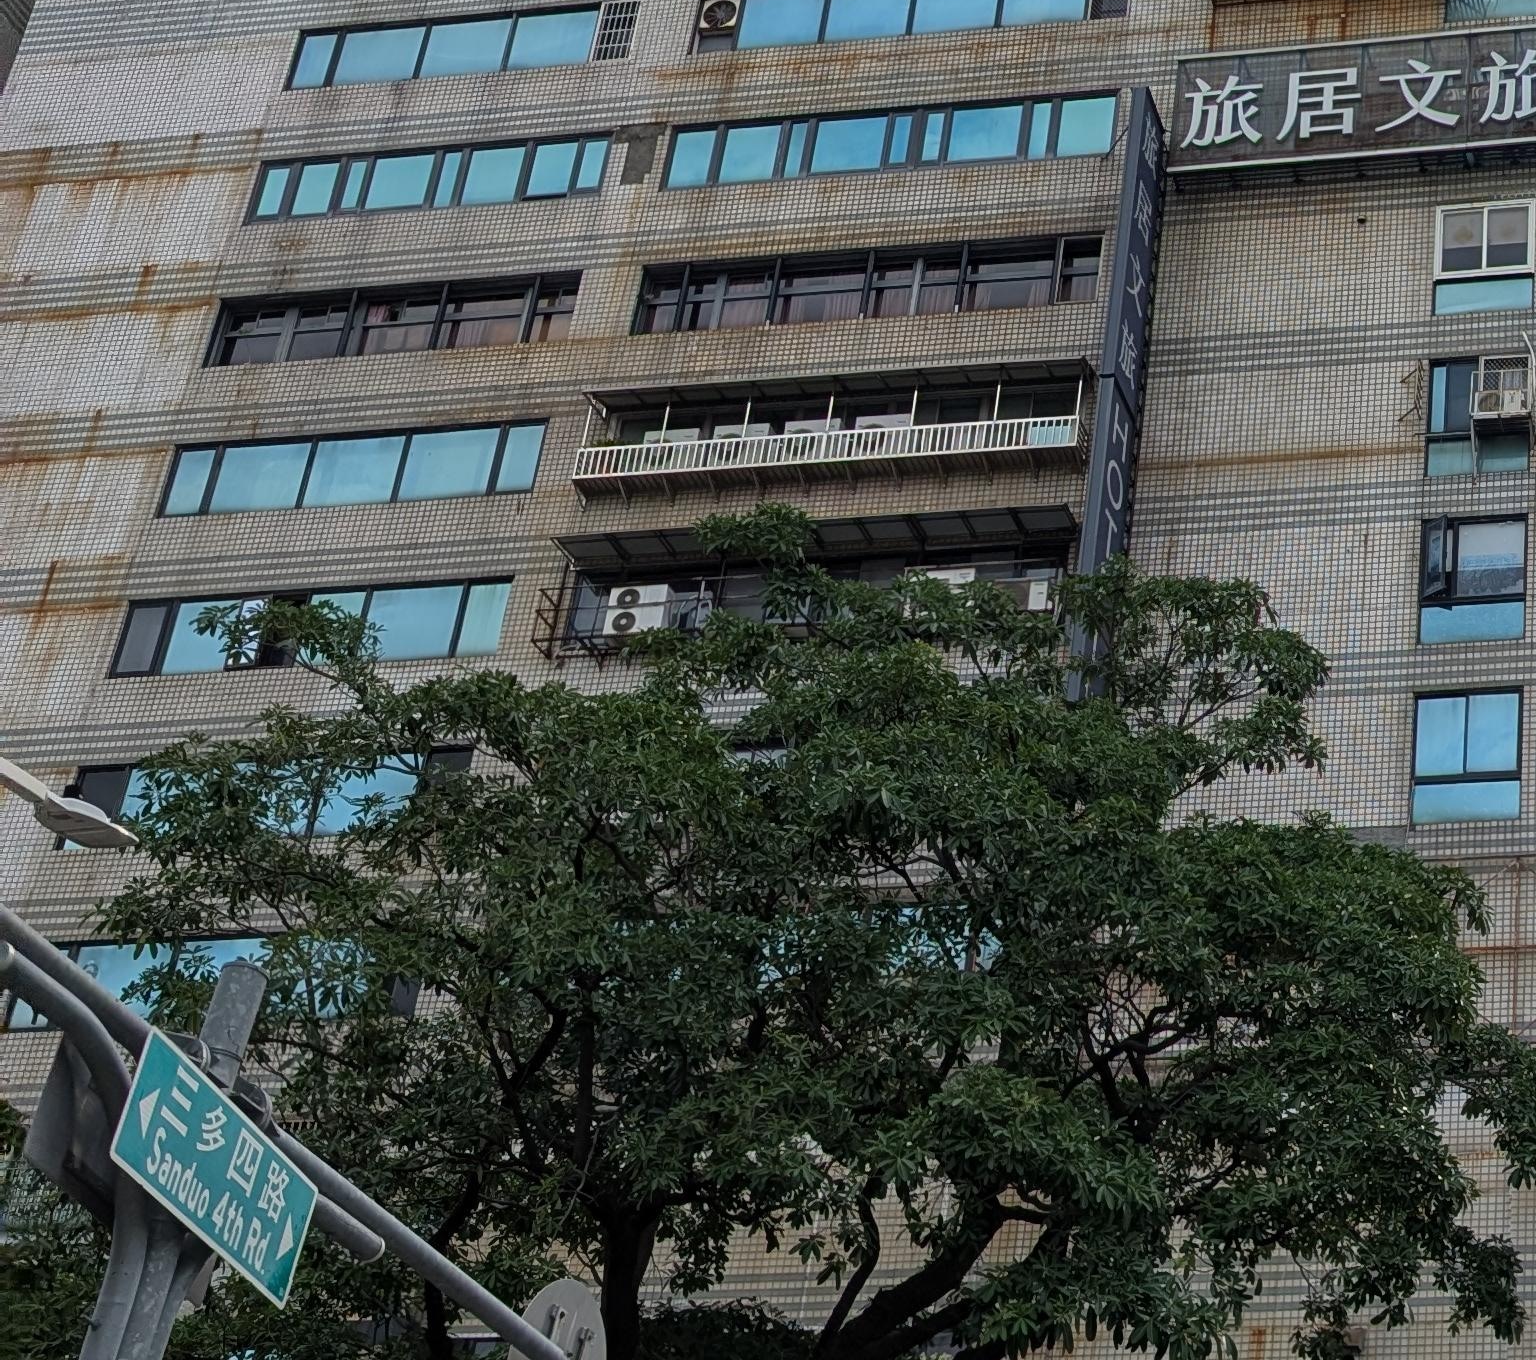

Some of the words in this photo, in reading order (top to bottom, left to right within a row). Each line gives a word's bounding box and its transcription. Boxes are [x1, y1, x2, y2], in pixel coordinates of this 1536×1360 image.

[1116, 111, 1159, 391] 旅居文旅
[146, 1127, 211, 1219] Sanduo
[211, 1191, 244, 1251] 4th
[242, 1216, 273, 1275] Rd.
[160, 1064, 290, 1223] 三多四路
